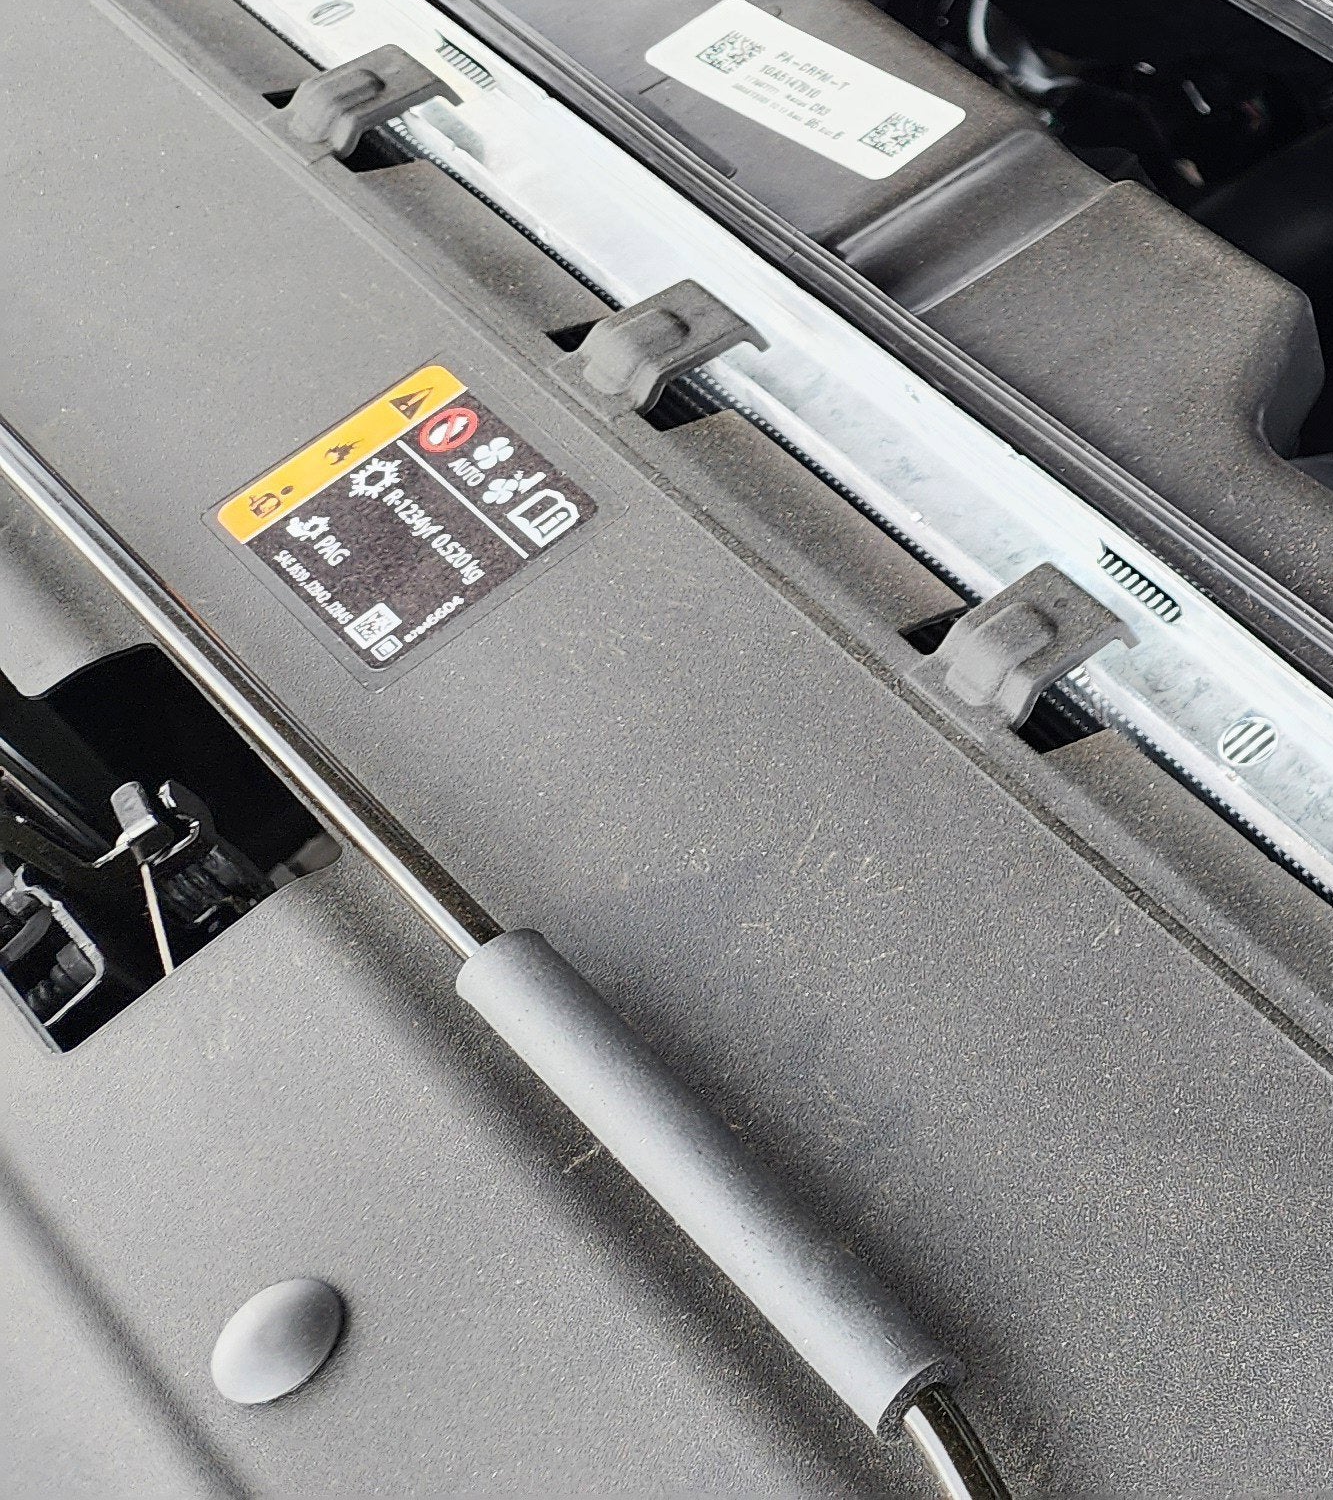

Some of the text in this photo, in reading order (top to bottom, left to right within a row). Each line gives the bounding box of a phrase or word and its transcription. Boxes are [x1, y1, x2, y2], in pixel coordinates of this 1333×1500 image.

[447, 457, 486, 487] AUTO
[313, 535, 351, 567] PAG
[382, 488, 486, 586] R-1234yf 0.520 kg
[273, 550, 297, 569] SAE
